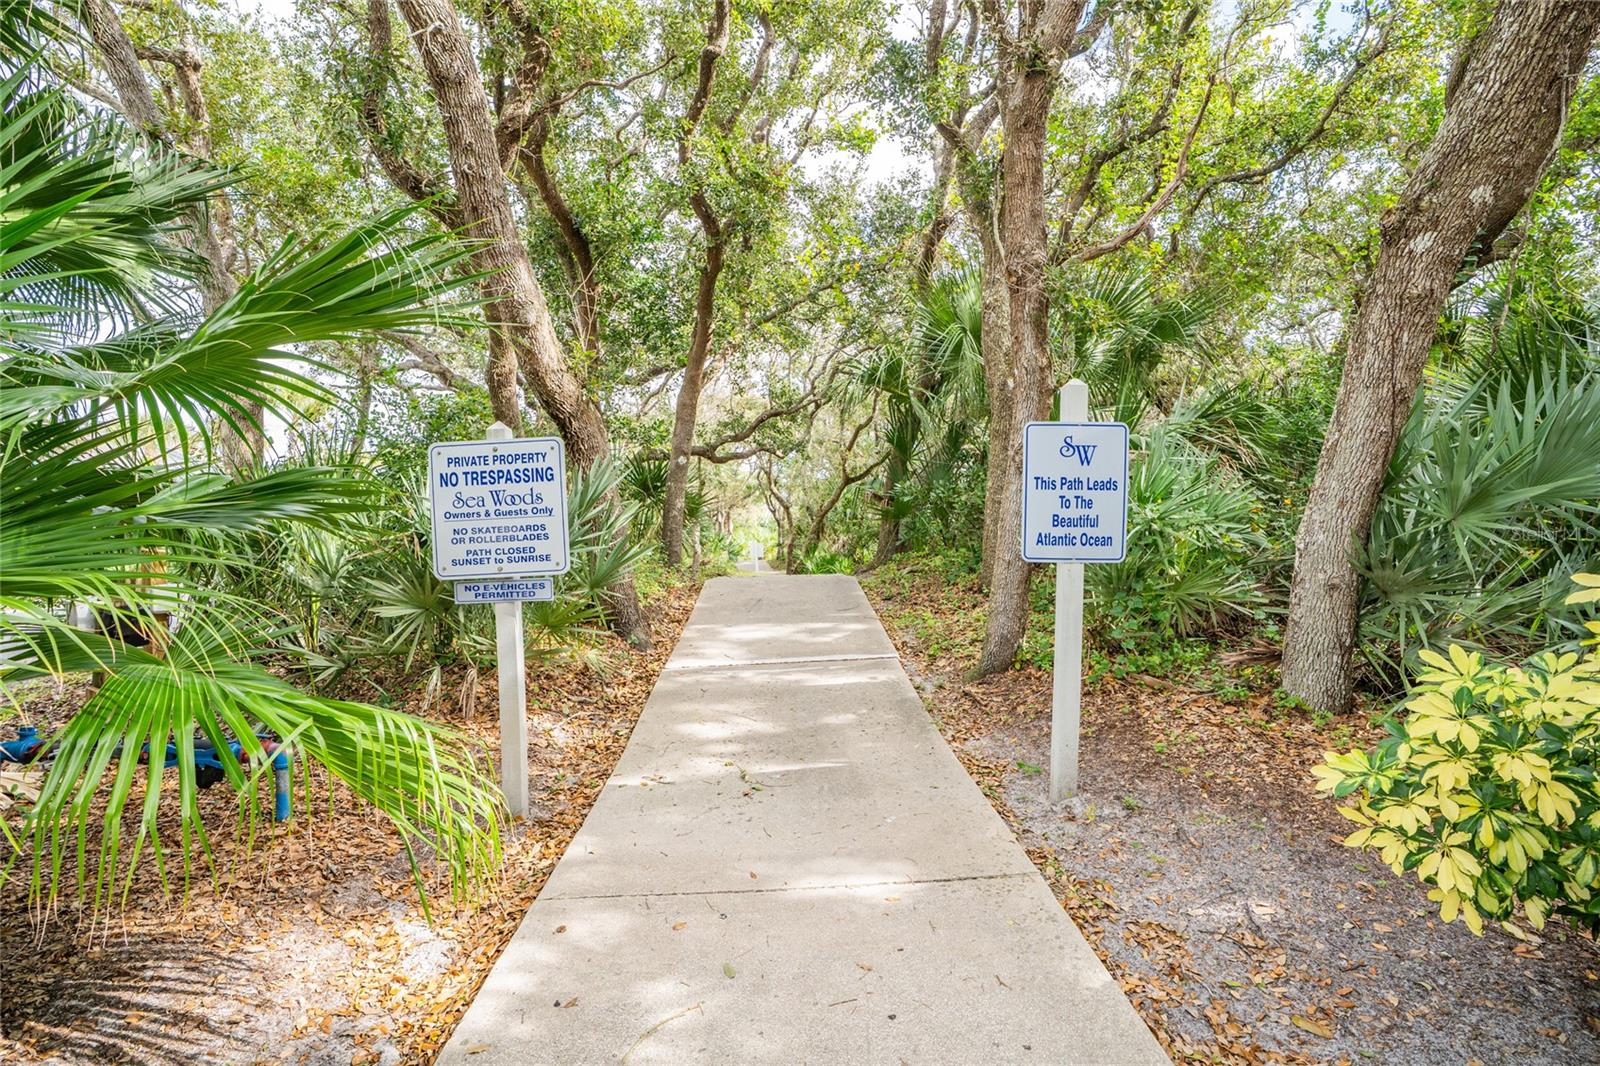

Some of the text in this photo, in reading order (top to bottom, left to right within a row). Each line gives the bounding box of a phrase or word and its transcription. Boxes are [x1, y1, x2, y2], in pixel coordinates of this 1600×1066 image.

[447, 452, 547, 467] PRIVATE PROPERTY
[440, 467, 554, 487] NO TRESPASSING
[1034, 477, 1118, 491] This Path Leads
[453, 488, 543, 509] Sea Woods
[1059, 496, 1093, 509] To The
[494, 509, 528, 517] Guests
[531, 507, 553, 516] Only
[1052, 514, 1099, 528] Beautiful
[471, 524, 546, 534] SKATEBOARDS
[469, 533, 549, 544] ROLLERBLADES
[1036, 533, 1112, 546] Atlantic Ocean
[466, 547, 535, 557] PATH CLOSED
[452, 558, 491, 566] SUNSET
[507, 554, 551, 563] SUNRISE
[483, 583, 545, 591] E-VEHICLES
[475, 591, 535, 599] PERMITTED
